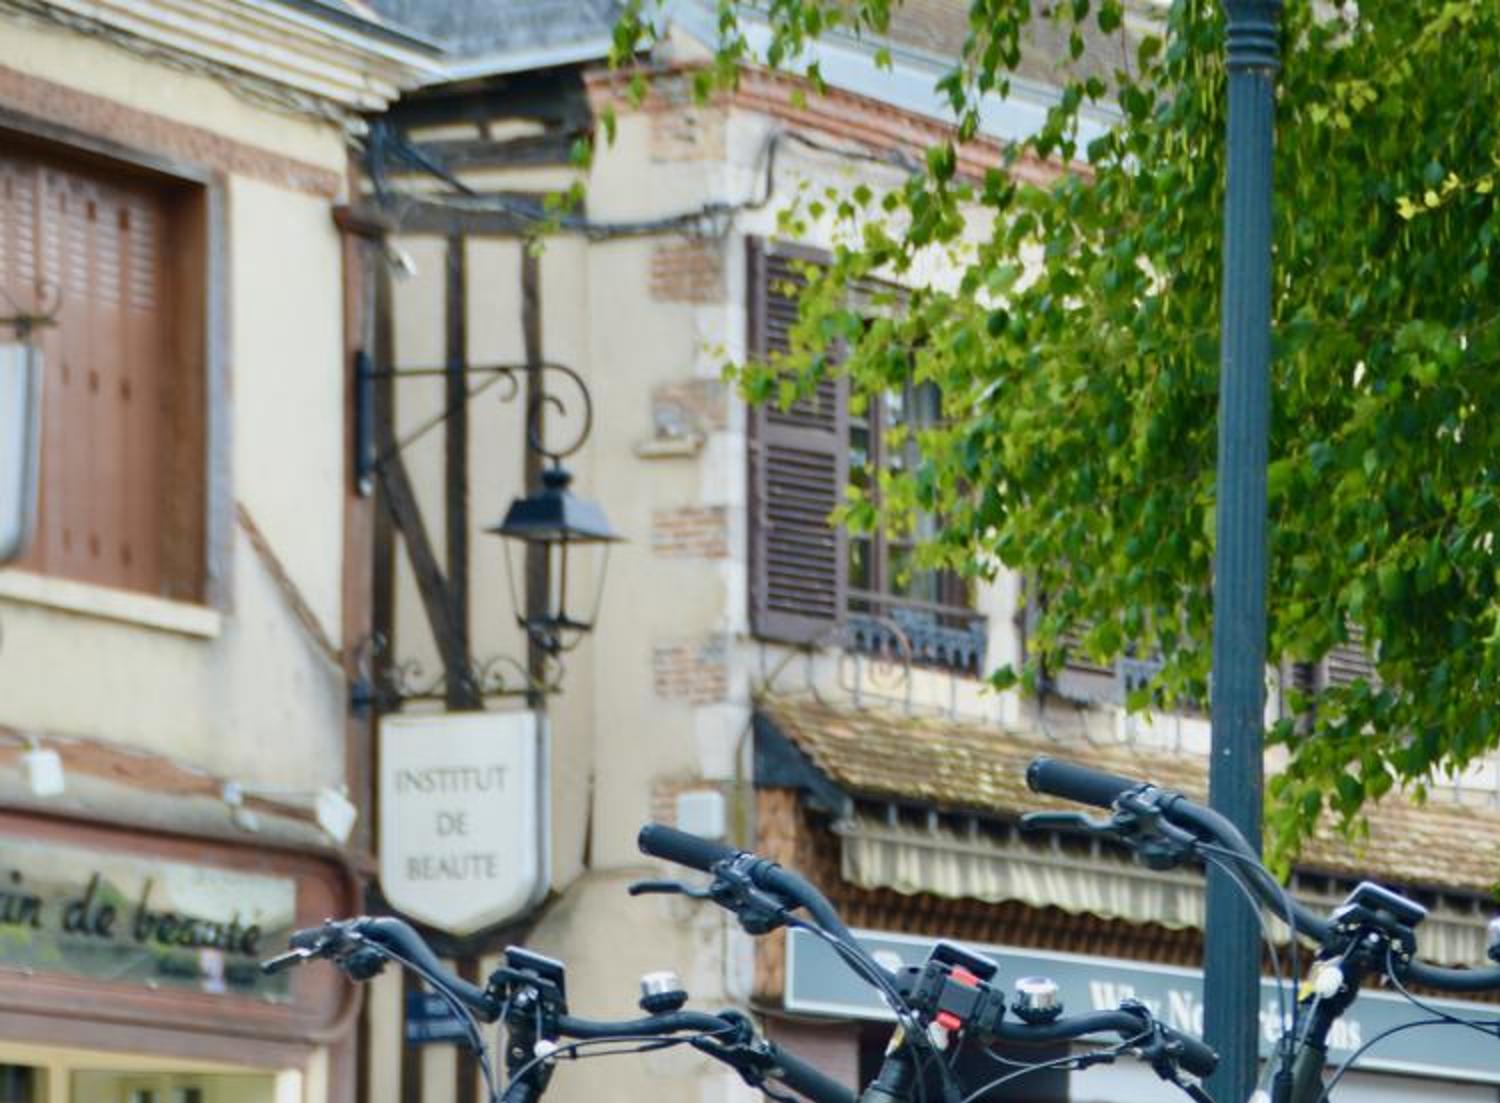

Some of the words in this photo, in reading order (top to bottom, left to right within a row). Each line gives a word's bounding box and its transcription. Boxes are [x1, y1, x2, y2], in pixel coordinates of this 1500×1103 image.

[395, 765, 509, 794] INSTITUT
[437, 811, 468, 837] DE
[407, 854, 498, 882] BEAUTE
[63, 872, 116, 938] de
